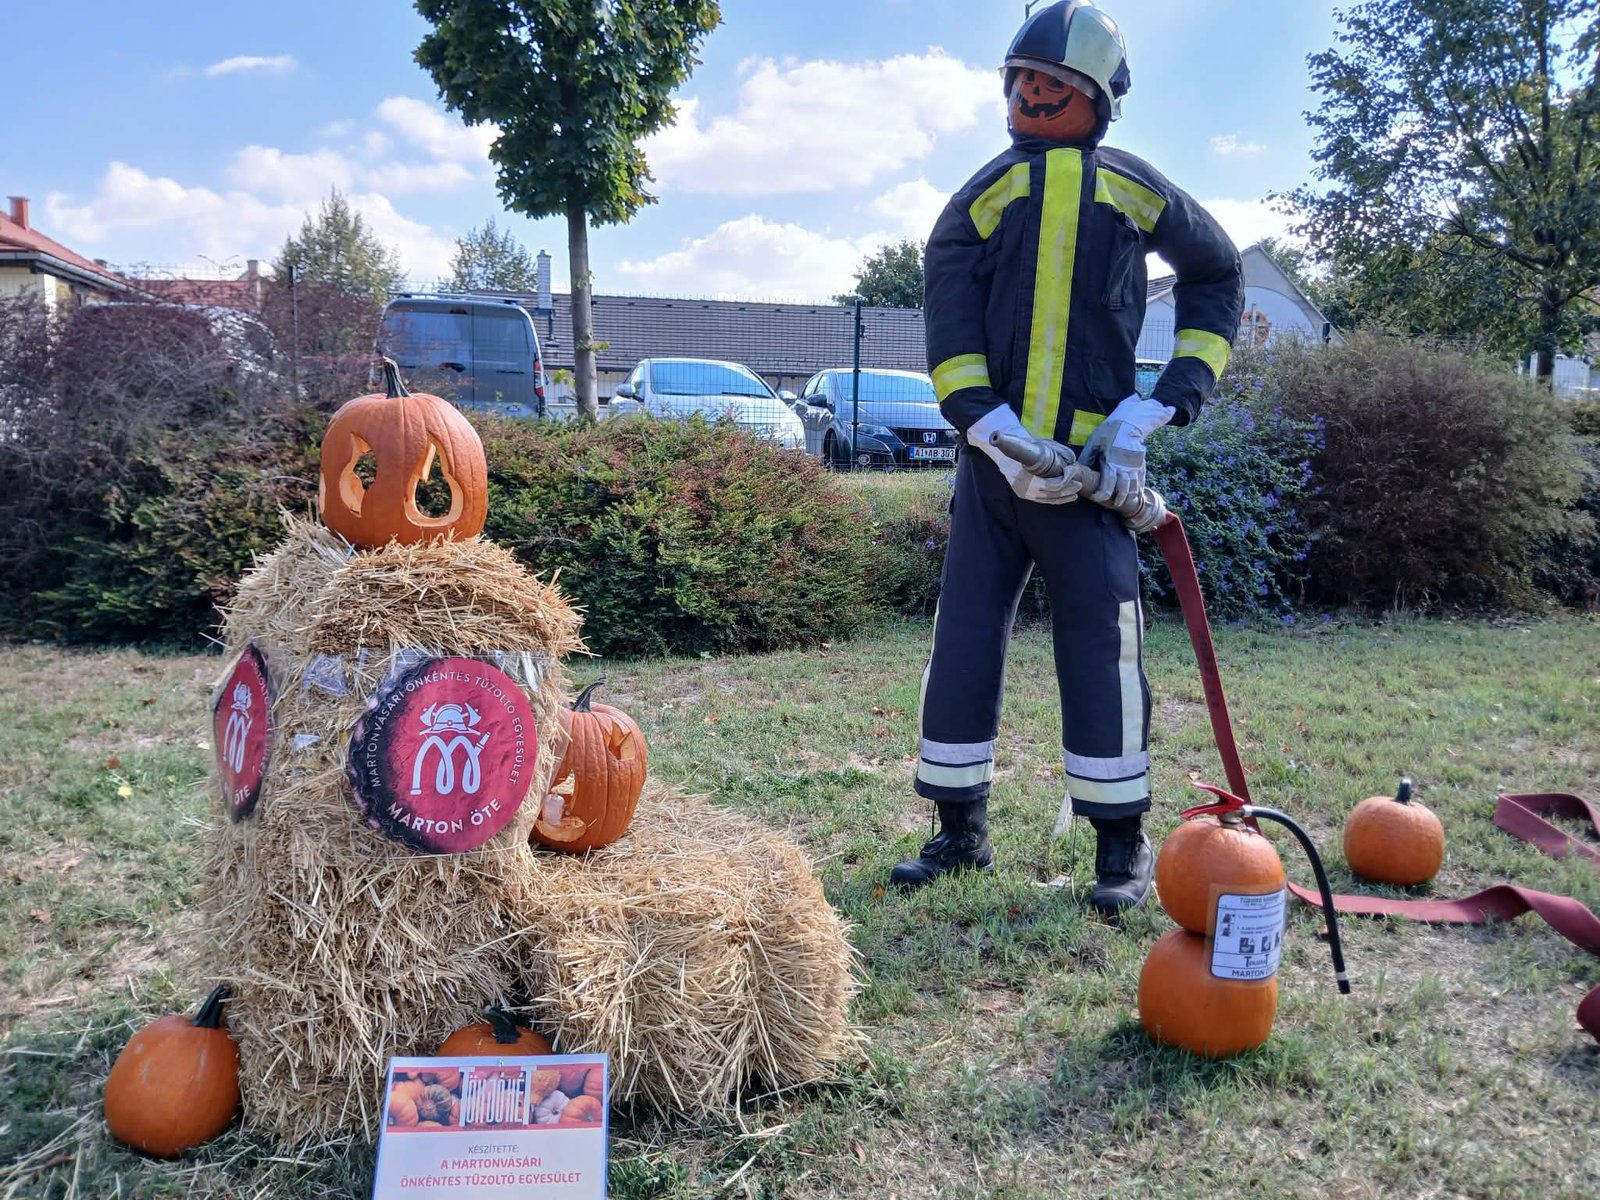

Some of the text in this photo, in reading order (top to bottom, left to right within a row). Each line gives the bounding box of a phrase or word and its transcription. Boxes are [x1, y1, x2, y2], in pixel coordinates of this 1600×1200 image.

[406, 671, 470, 693] ÖNKÉNTES
[508, 716, 525, 785] EGYESÜLET
[234, 785, 251, 806] ÖTE
[387, 797, 501, 834] MARTON ÖTE
[1231, 969, 1265, 978] MARTON
[440, 1156, 542, 1170] A MARTONVÁSÁRI
[400, 1174, 462, 1188] ÖNKÉNTES
[518, 1170, 582, 1185] EGYESÜLET
